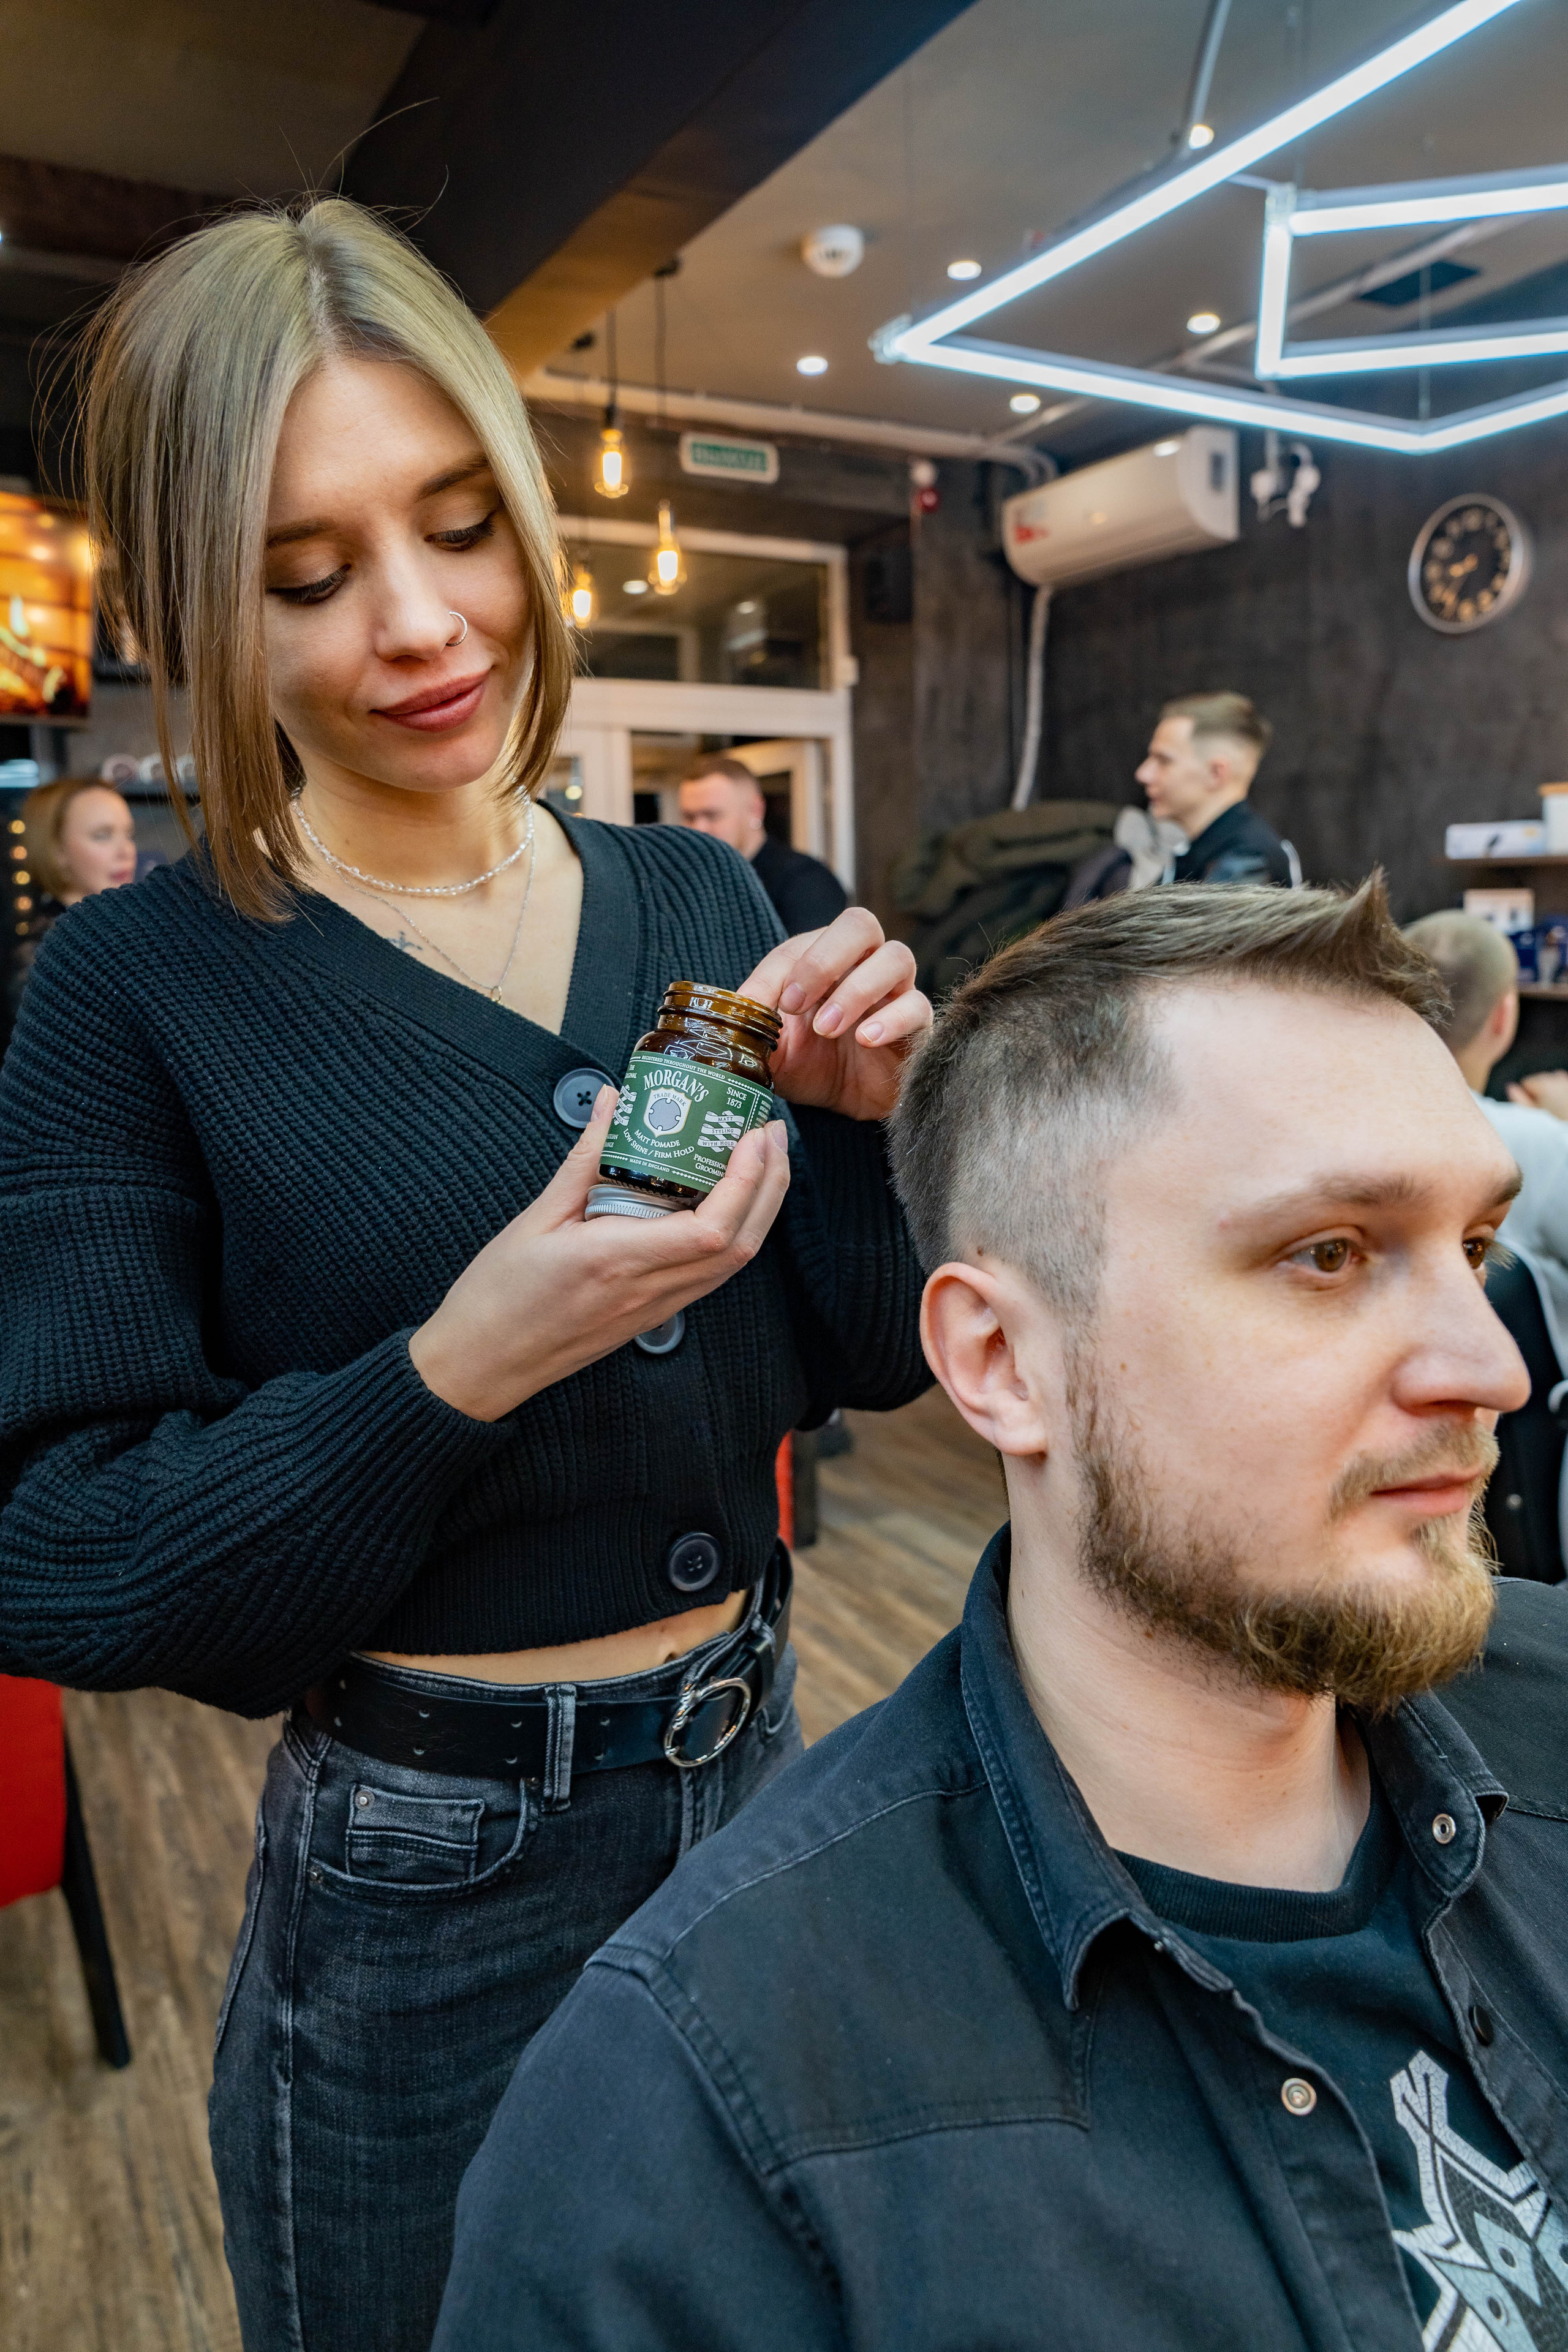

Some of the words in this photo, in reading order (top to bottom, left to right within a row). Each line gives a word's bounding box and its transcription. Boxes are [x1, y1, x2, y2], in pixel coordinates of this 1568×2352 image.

[663, 1058, 696, 1071] THROUGHOUT
[707, 1070, 725, 1079] WORLD
[643, 1069, 709, 1102] MORGAN'S
[726, 1087, 747, 1101] SINCE
[672, 1095, 686, 1106] MARK
[726, 1098, 742, 1109] 1873
[624, 1128, 633, 1142] LOW
[630, 1140, 649, 1155] SHINE
[674, 1146, 695, 1158] HOLD
[634, 1129, 650, 1144] MATT
[650, 1139, 680, 1148] POMADE
[647, 1162, 670, 1172] ENGLAND
[693, 1153, 727, 1170] PROFESSION
